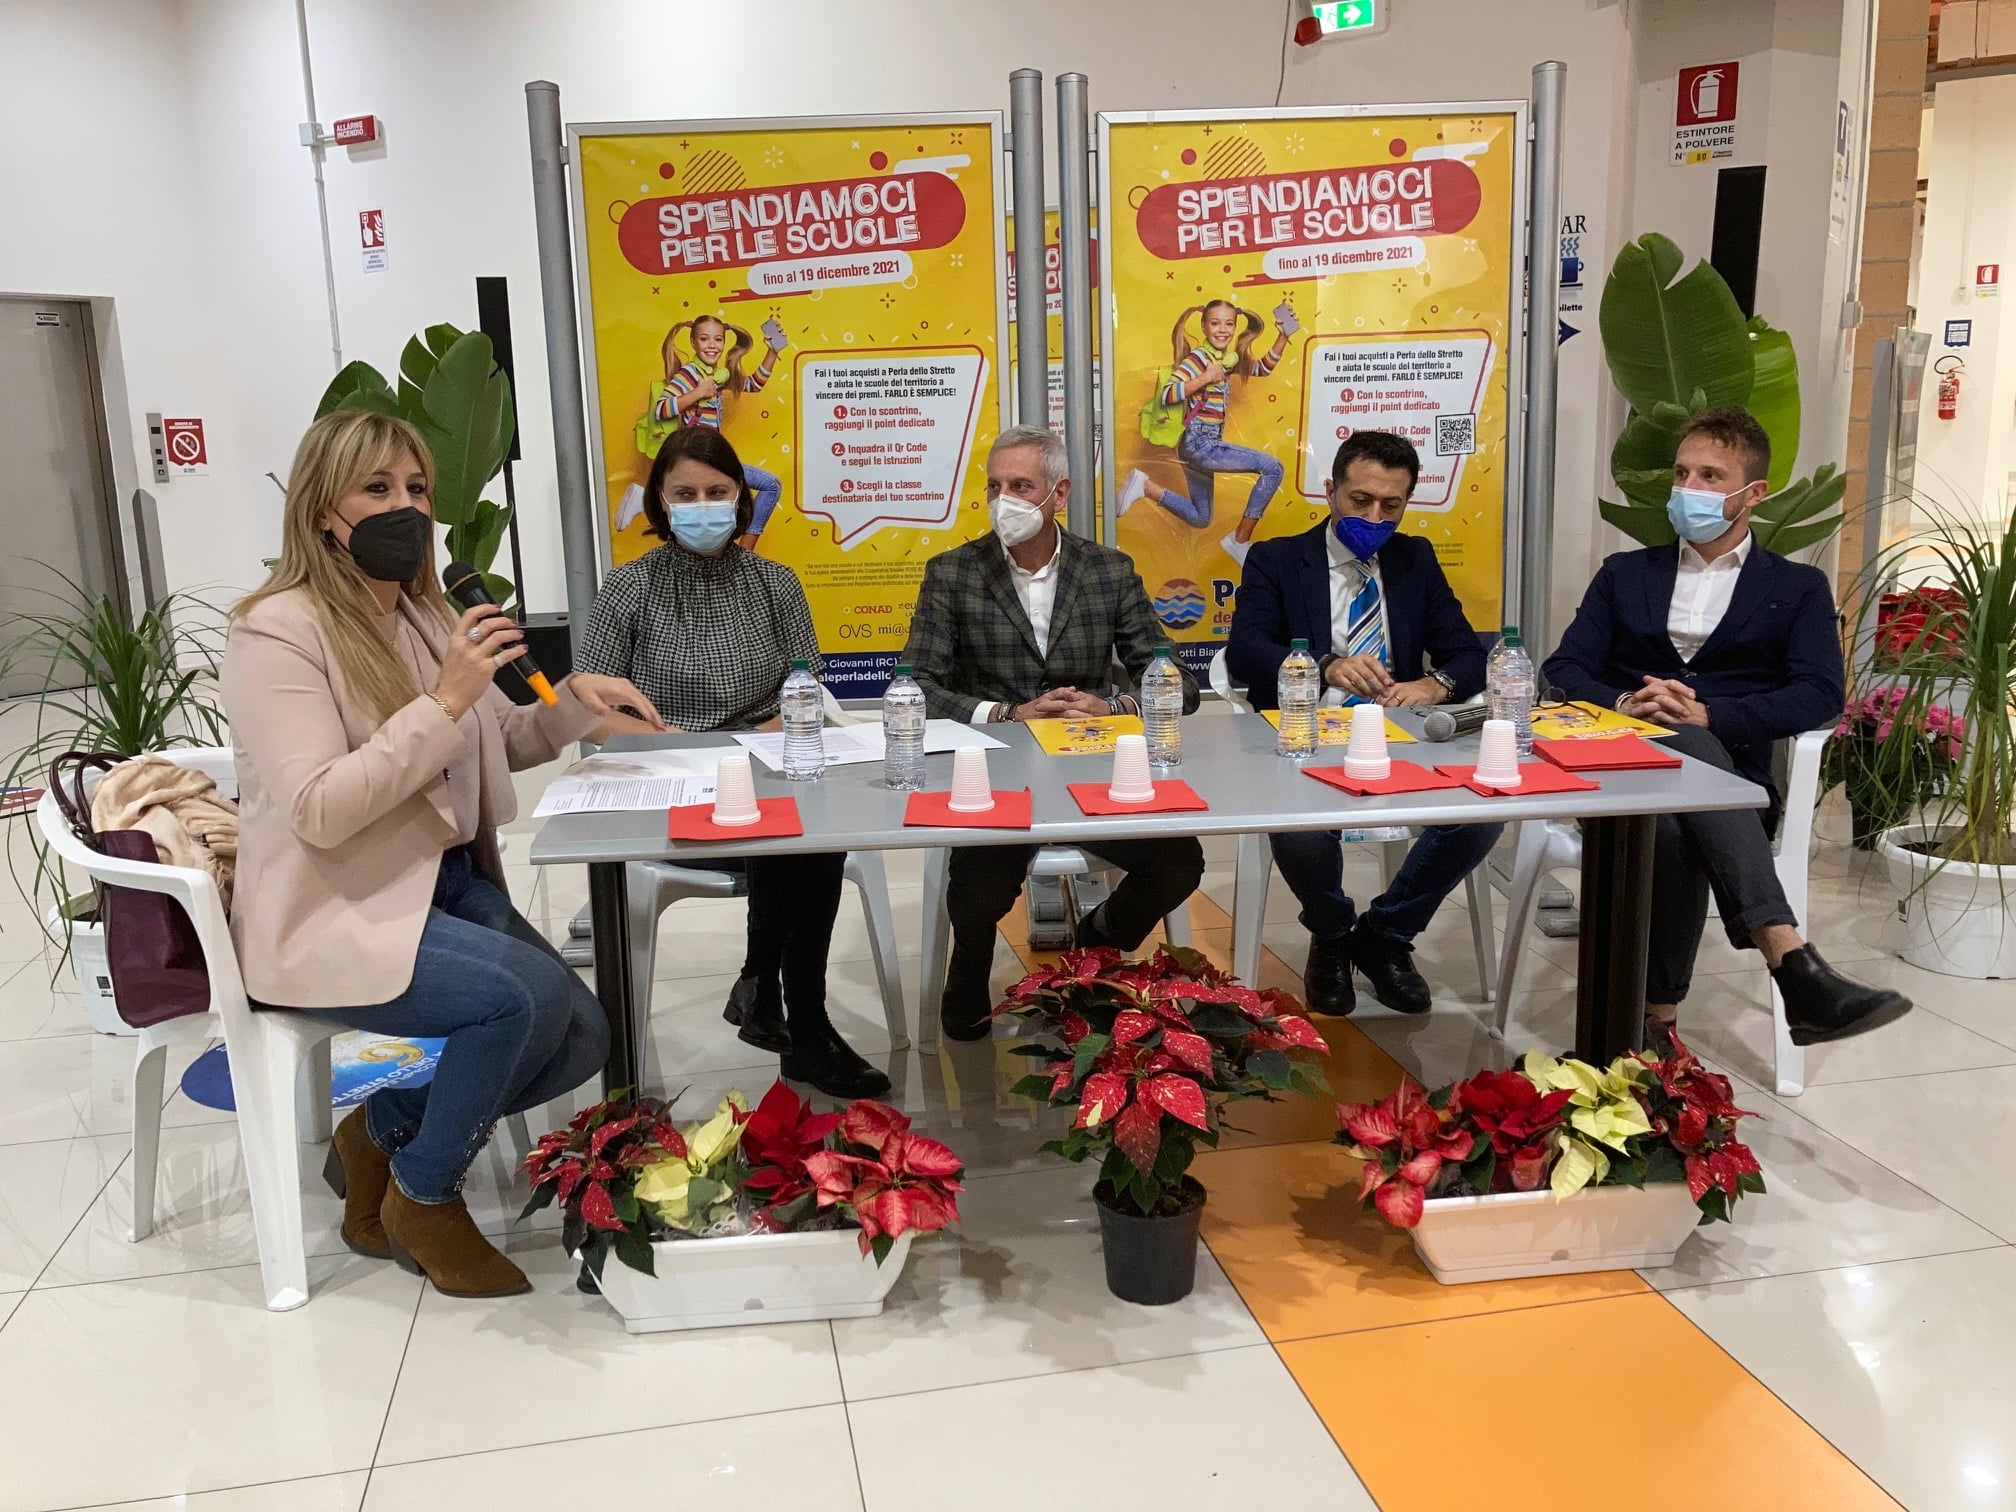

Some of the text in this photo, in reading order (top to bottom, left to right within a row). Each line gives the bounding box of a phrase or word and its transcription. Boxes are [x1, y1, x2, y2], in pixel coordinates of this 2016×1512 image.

[336, 121, 363, 132] ALLARME
[1676, 125, 1735, 139] ESTINTORE
[336, 128, 364, 139] INCENDIO
[1675, 137, 1734, 150] A POLVERE
[1177, 165, 1433, 223] SPENDIAMOCI
[658, 179, 917, 237] SPENDIAMOCI
[1178, 201, 1436, 253] PER LE SCUOLE
[1561, 215, 1587, 234] AR
[660, 214, 921, 268] PER LE SCUOLE
[1278, 246, 1414, 271] fino al 19 dicembre 2021
[763, 260, 900, 286] fino al 19 dicembre 2021
[1324, 352, 1336, 361] Fai
[1341, 351, 1357, 361] tuoi
[1358, 351, 1388, 362] acquisti
[1396, 351, 1416, 360] Perla
[1417, 350, 1436, 359] dello
[1437, 349, 1463, 358] Stretto
[814, 369, 827, 378] Fai
[828, 368, 832, 377] i
[832, 368, 848, 377] tuoi
[849, 367, 880, 378] acquisti
[888, 367, 908, 376] Perla
[909, 366, 929, 375] dello
[930, 366, 956, 375] Stretto
[1342, 363, 1362, 372] aiuta
[1363, 363, 1371, 371] le
[1372, 362, 1397, 371] scuole
[1398, 362, 1411, 371] del
[1411, 361, 1445, 370] territorio
[833, 380, 854, 388] aiuta
[855, 379, 863, 388] le
[864, 379, 889, 388] scuole
[890, 378, 903, 387] del
[904, 377, 938, 387] territorio
[1323, 374, 1351, 383] vincere
[1353, 373, 1365, 382] dei
[1366, 373, 1390, 384] premi.
[1391, 371, 1415, 381] FARLO
[1423, 371, 1463, 380] SEMPLICE!
[815, 387, 957, 401] vincere dei premi. FARLO È SEMPLICE!
[1343, 388, 1428, 400] 1. Con lo scontrino,
[836, 405, 922, 418] 1. Con lo scontrino,
[1331, 401, 1440, 414] raggiungi il point dedicato
[824, 418, 935, 431] raggiungi il point dedicato
[1339, 428, 1348, 438] 2.
[1399, 426, 1408, 435] Qr
[1410, 425, 1431, 435] Code
[834, 443, 928, 455] 2. Inquadra il Qr Code
[848, 456, 872, 468] segui
[873, 456, 882, 465] le
[883, 455, 922, 465] istruzioni
[842, 480, 922, 492] 3. Scegli la classe
[822, 491, 945, 504] destinataria del tuo scontrino
[854, 605, 893, 615] CONAD
[839, 623, 872, 639] OVS
[829, 657, 898, 668] Giovanni (RC)
